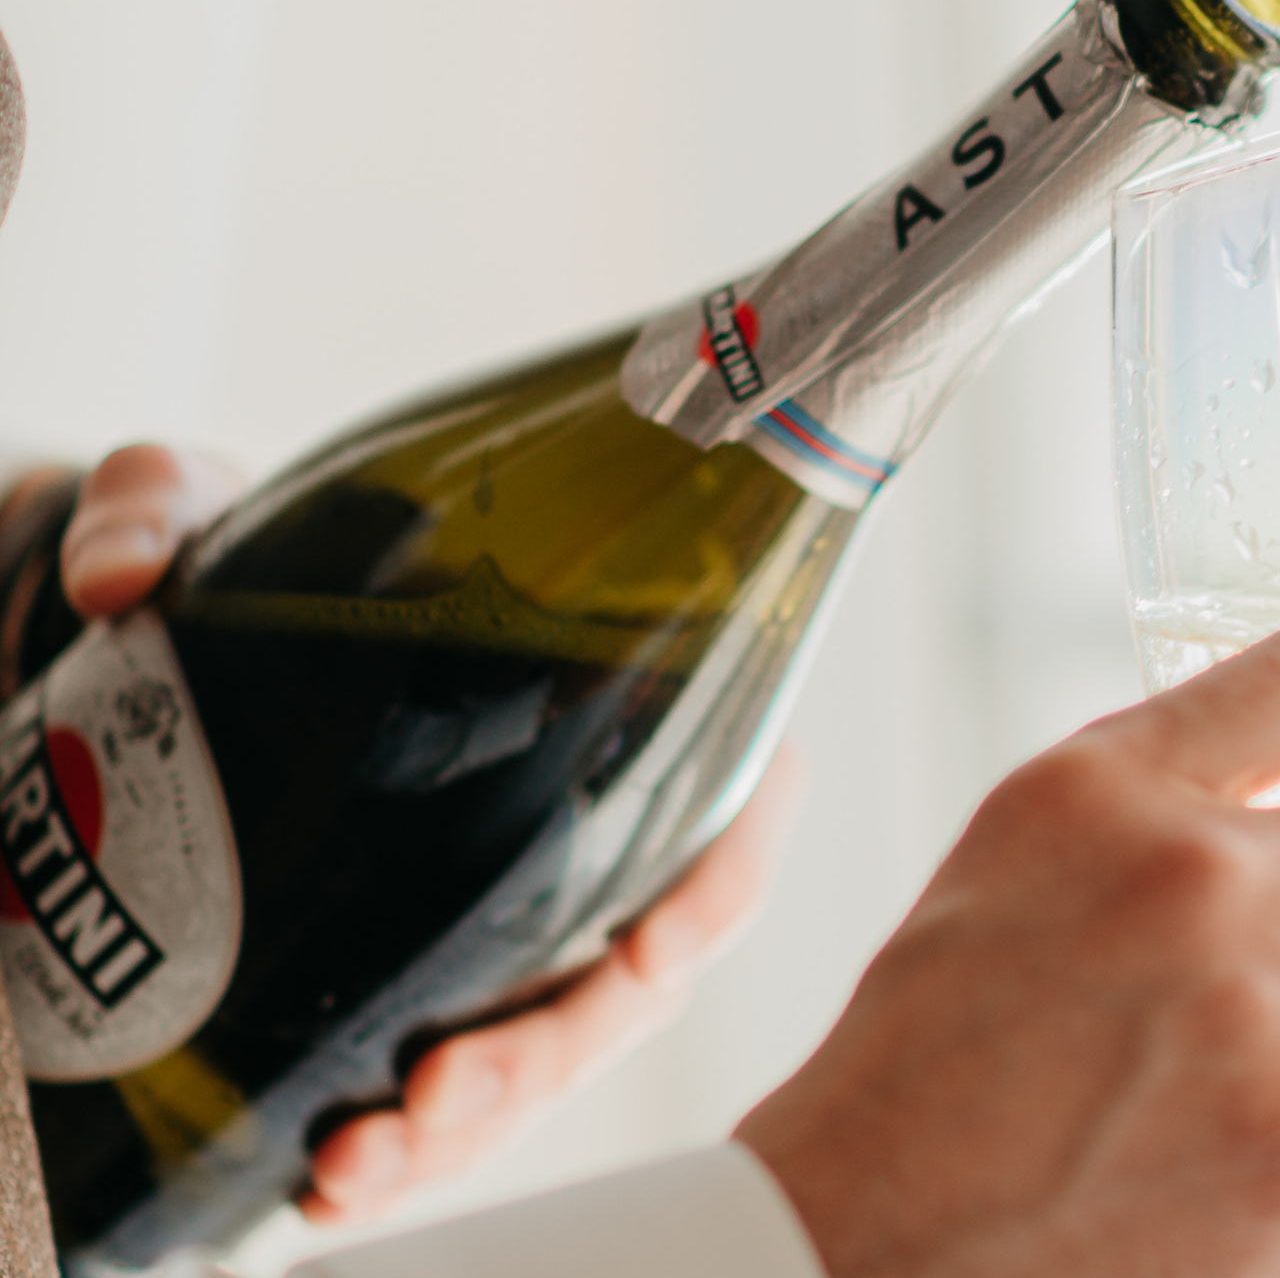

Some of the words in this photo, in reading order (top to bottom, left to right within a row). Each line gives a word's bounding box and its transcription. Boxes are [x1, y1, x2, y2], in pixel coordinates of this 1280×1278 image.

[893, 51, 1065, 252] AST
[707, 287, 761, 399] RTINI
[0, 699, 149, 995] ARTINI
